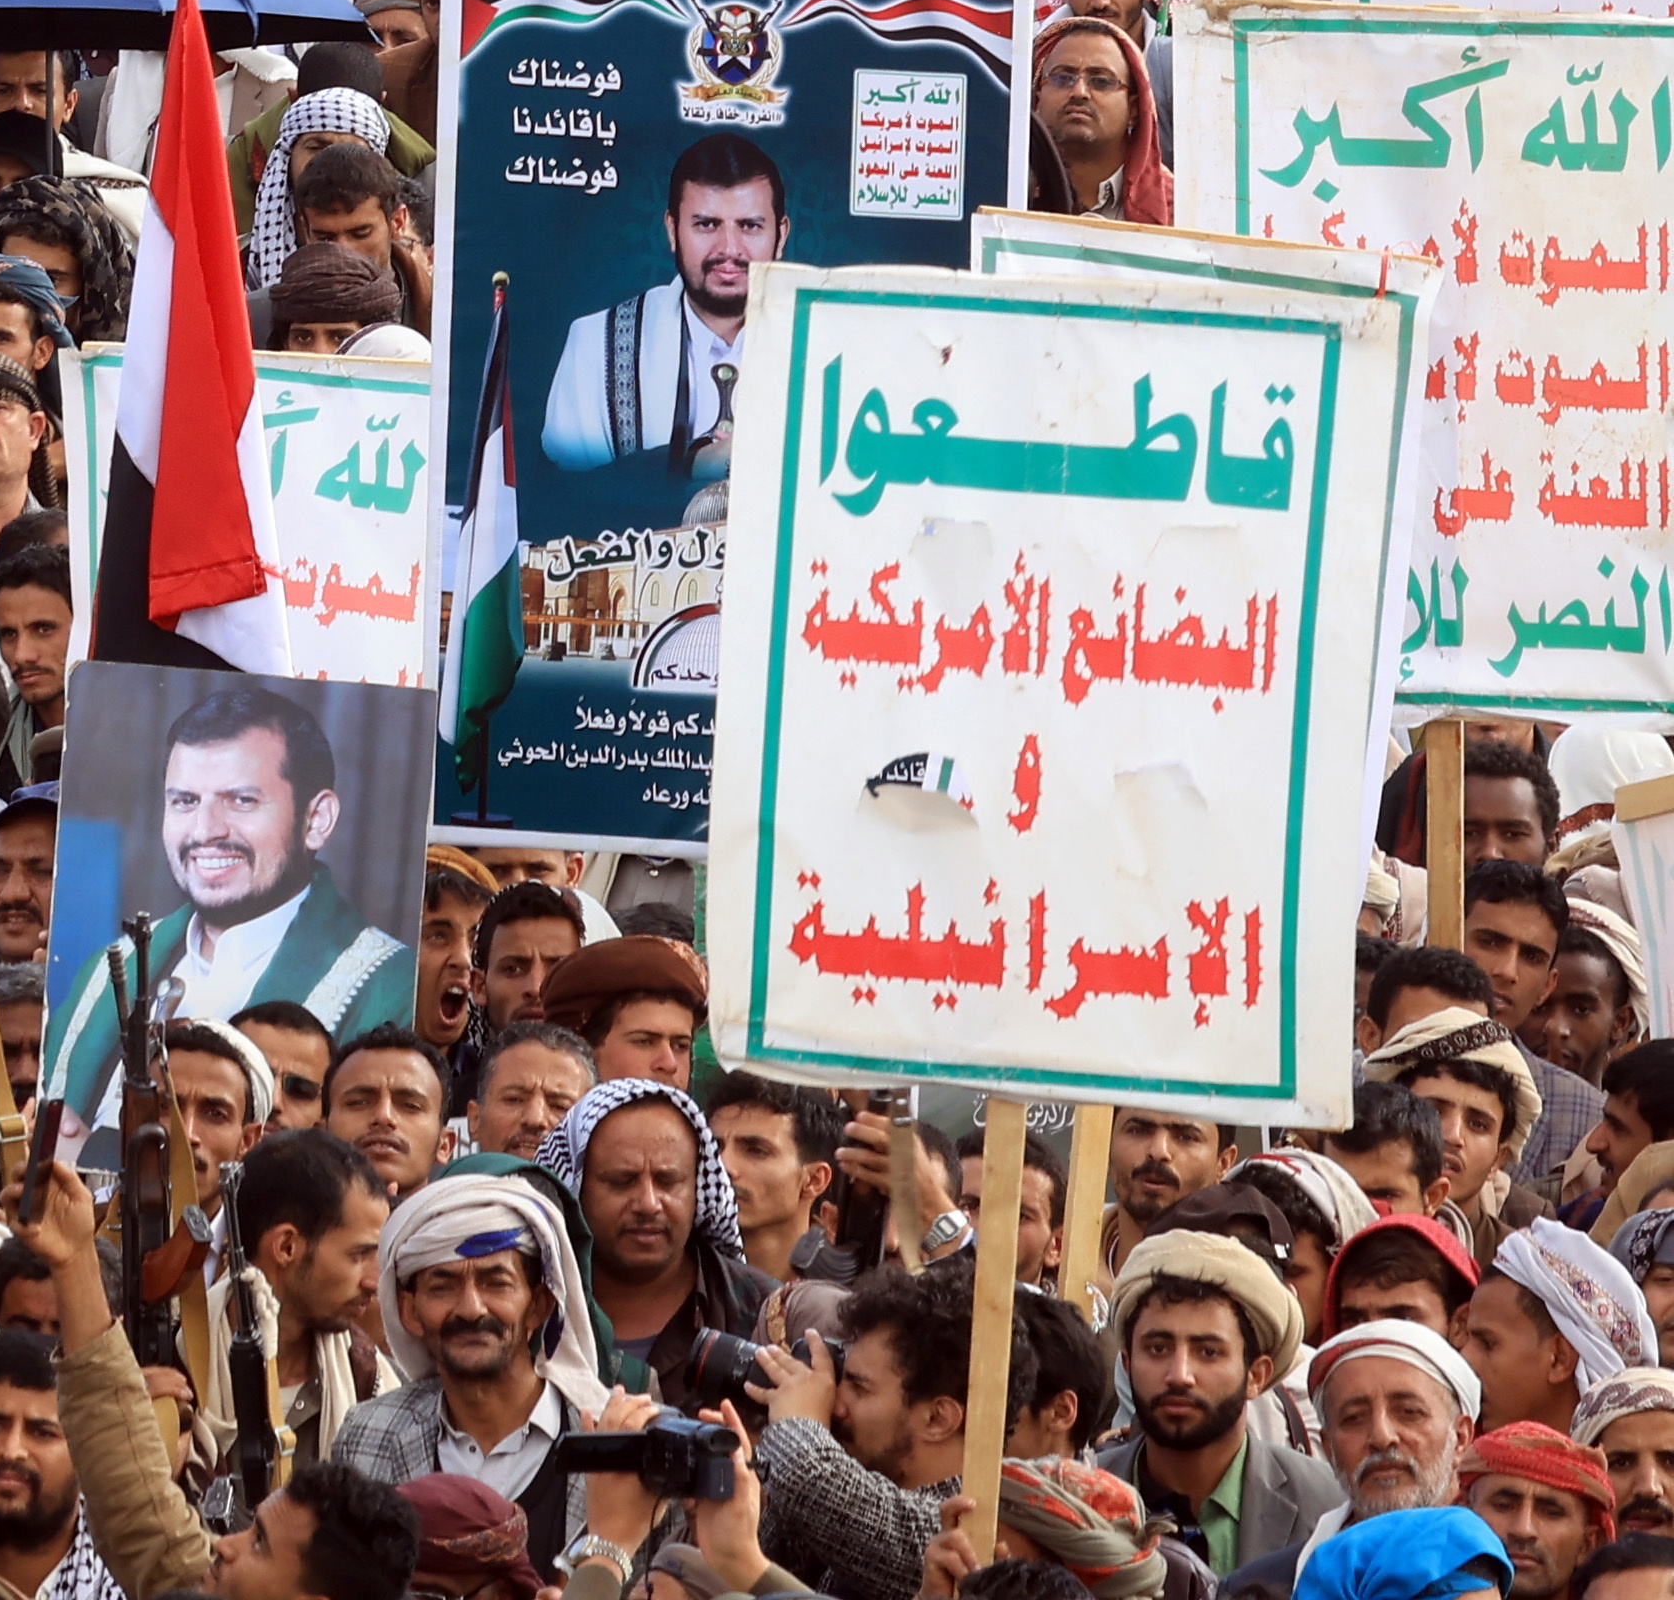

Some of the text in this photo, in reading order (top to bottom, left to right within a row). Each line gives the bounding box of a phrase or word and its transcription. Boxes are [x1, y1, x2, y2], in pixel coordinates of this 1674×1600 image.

[509, 59, 620, 96] فوضناك
[861, 78, 960, 106] الله أكبر
[861, 110, 959, 133] الموت لأمريكا
[1260, 47, 1509, 202] أكبر
[860, 135, 958, 156] الموت لإسرائيل
[506, 156, 617, 194] فوضناك
[859, 161, 957, 180] اللعنة على اليهود
[857, 183, 956, 209] النصر للإسلام
[1498, 222, 1671, 307] الموت
[820, 355, 1295, 517] قاطعوا
[1433, 450, 1672, 538] اللعنة على
[547, 528, 674, 582] والفعل
[801, 551, 1279, 713] البضائع الأمريكية
[498, 738, 563, 766] الحوثي
[1006, 733, 1044, 834] و
[787, 870, 1265, 1028] الإسرائيلية
